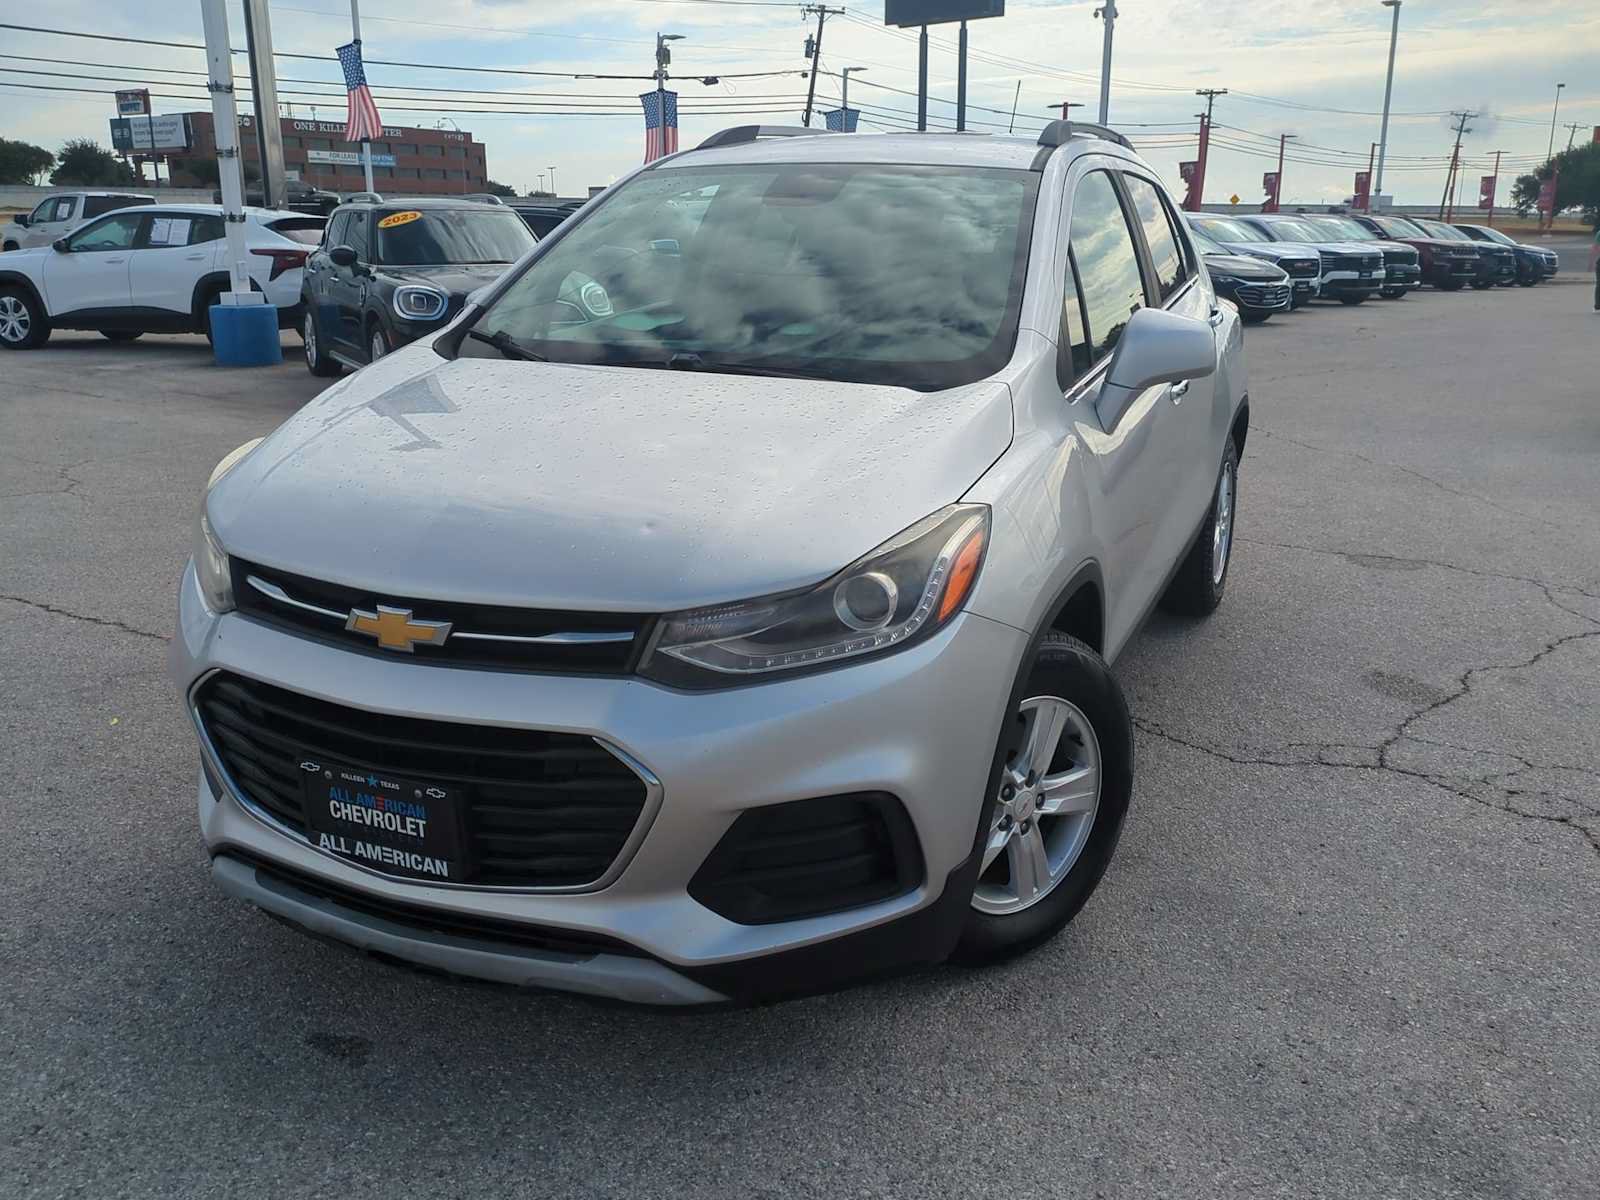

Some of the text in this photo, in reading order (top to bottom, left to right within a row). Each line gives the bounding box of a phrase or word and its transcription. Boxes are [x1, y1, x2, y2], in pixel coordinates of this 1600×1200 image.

[294, 121, 402, 137] ONE KILLE TER
[383, 212, 417, 226] 2023
[341, 772, 400, 790] KILLEEN TEXAS
[329, 786, 426, 818] ALL AMERICAN
[329, 799, 426, 838] CHEVROLET
[319, 832, 449, 877] ALL AMERICAN
